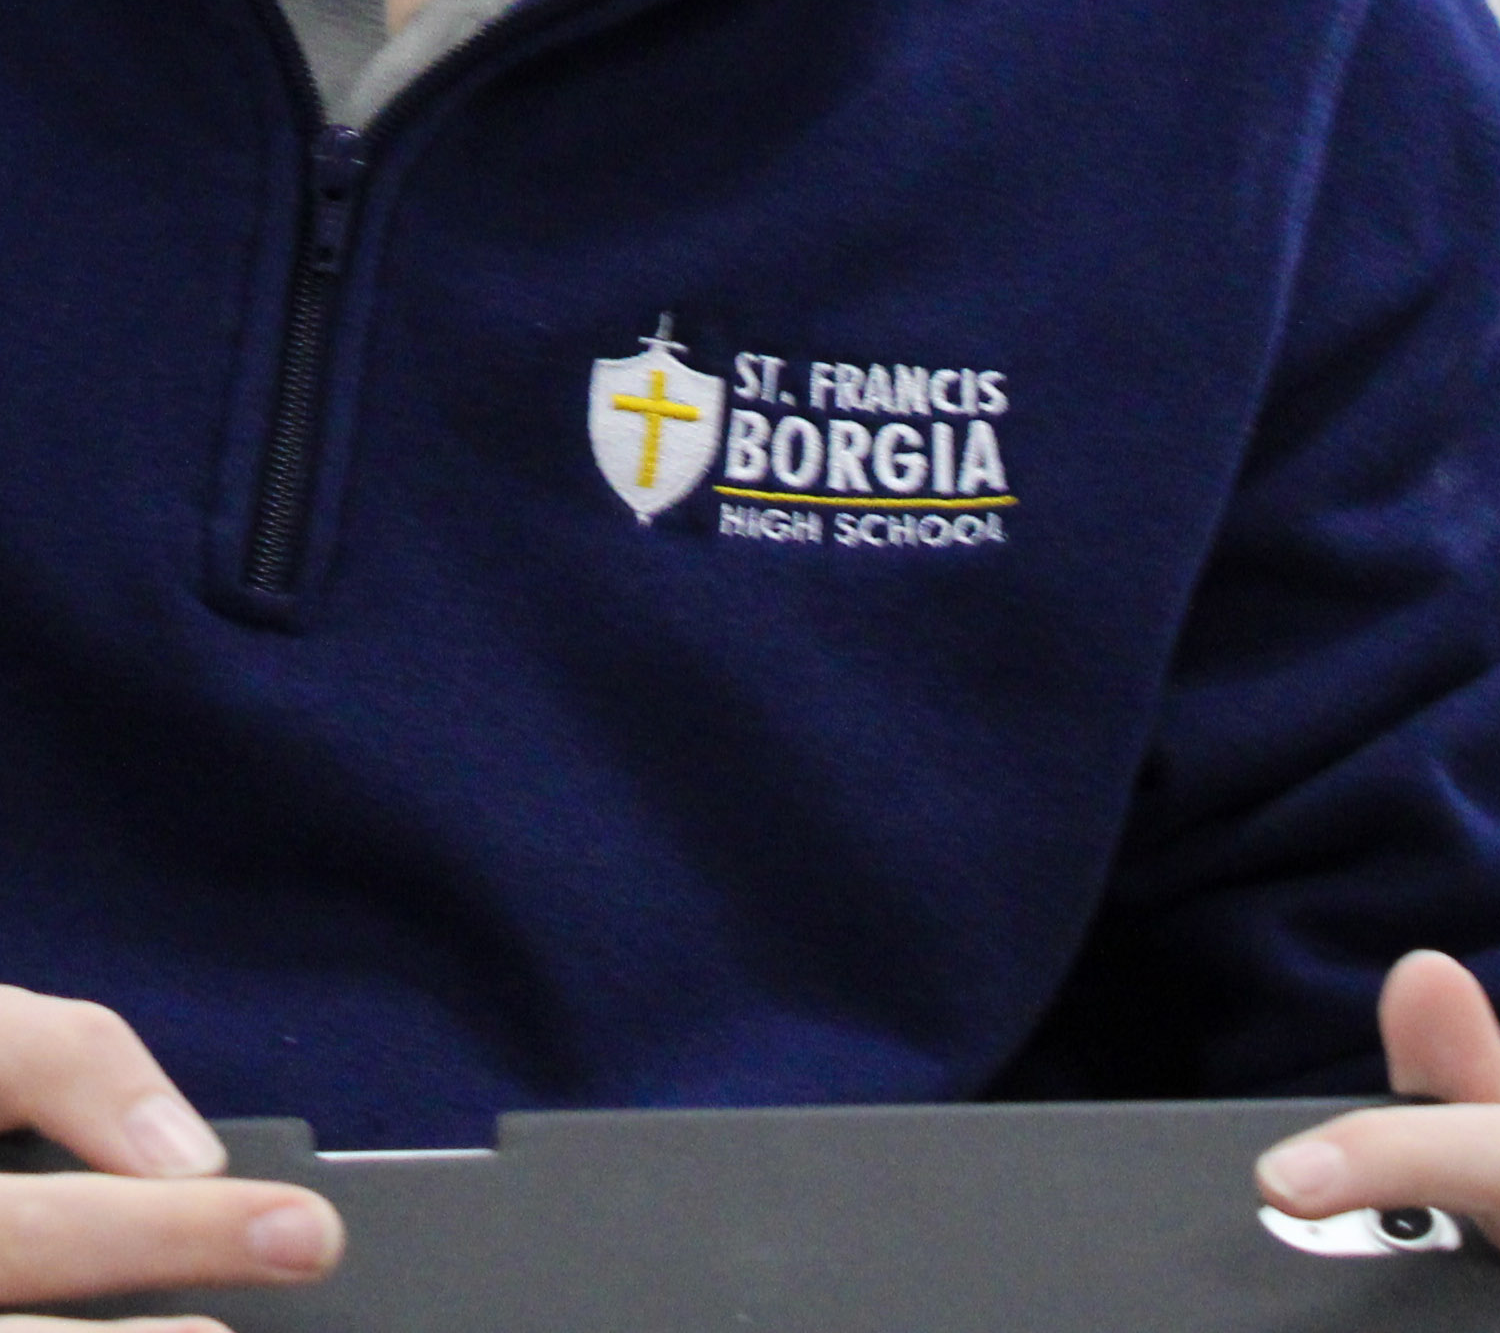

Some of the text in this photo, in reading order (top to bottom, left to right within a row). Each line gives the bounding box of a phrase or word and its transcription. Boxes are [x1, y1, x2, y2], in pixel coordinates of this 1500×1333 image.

[733, 352, 1009, 416] ST. FRANCIS
[725, 408, 1009, 494] BORGIA
[719, 503, 1006, 548] HIGH SCHOOL
